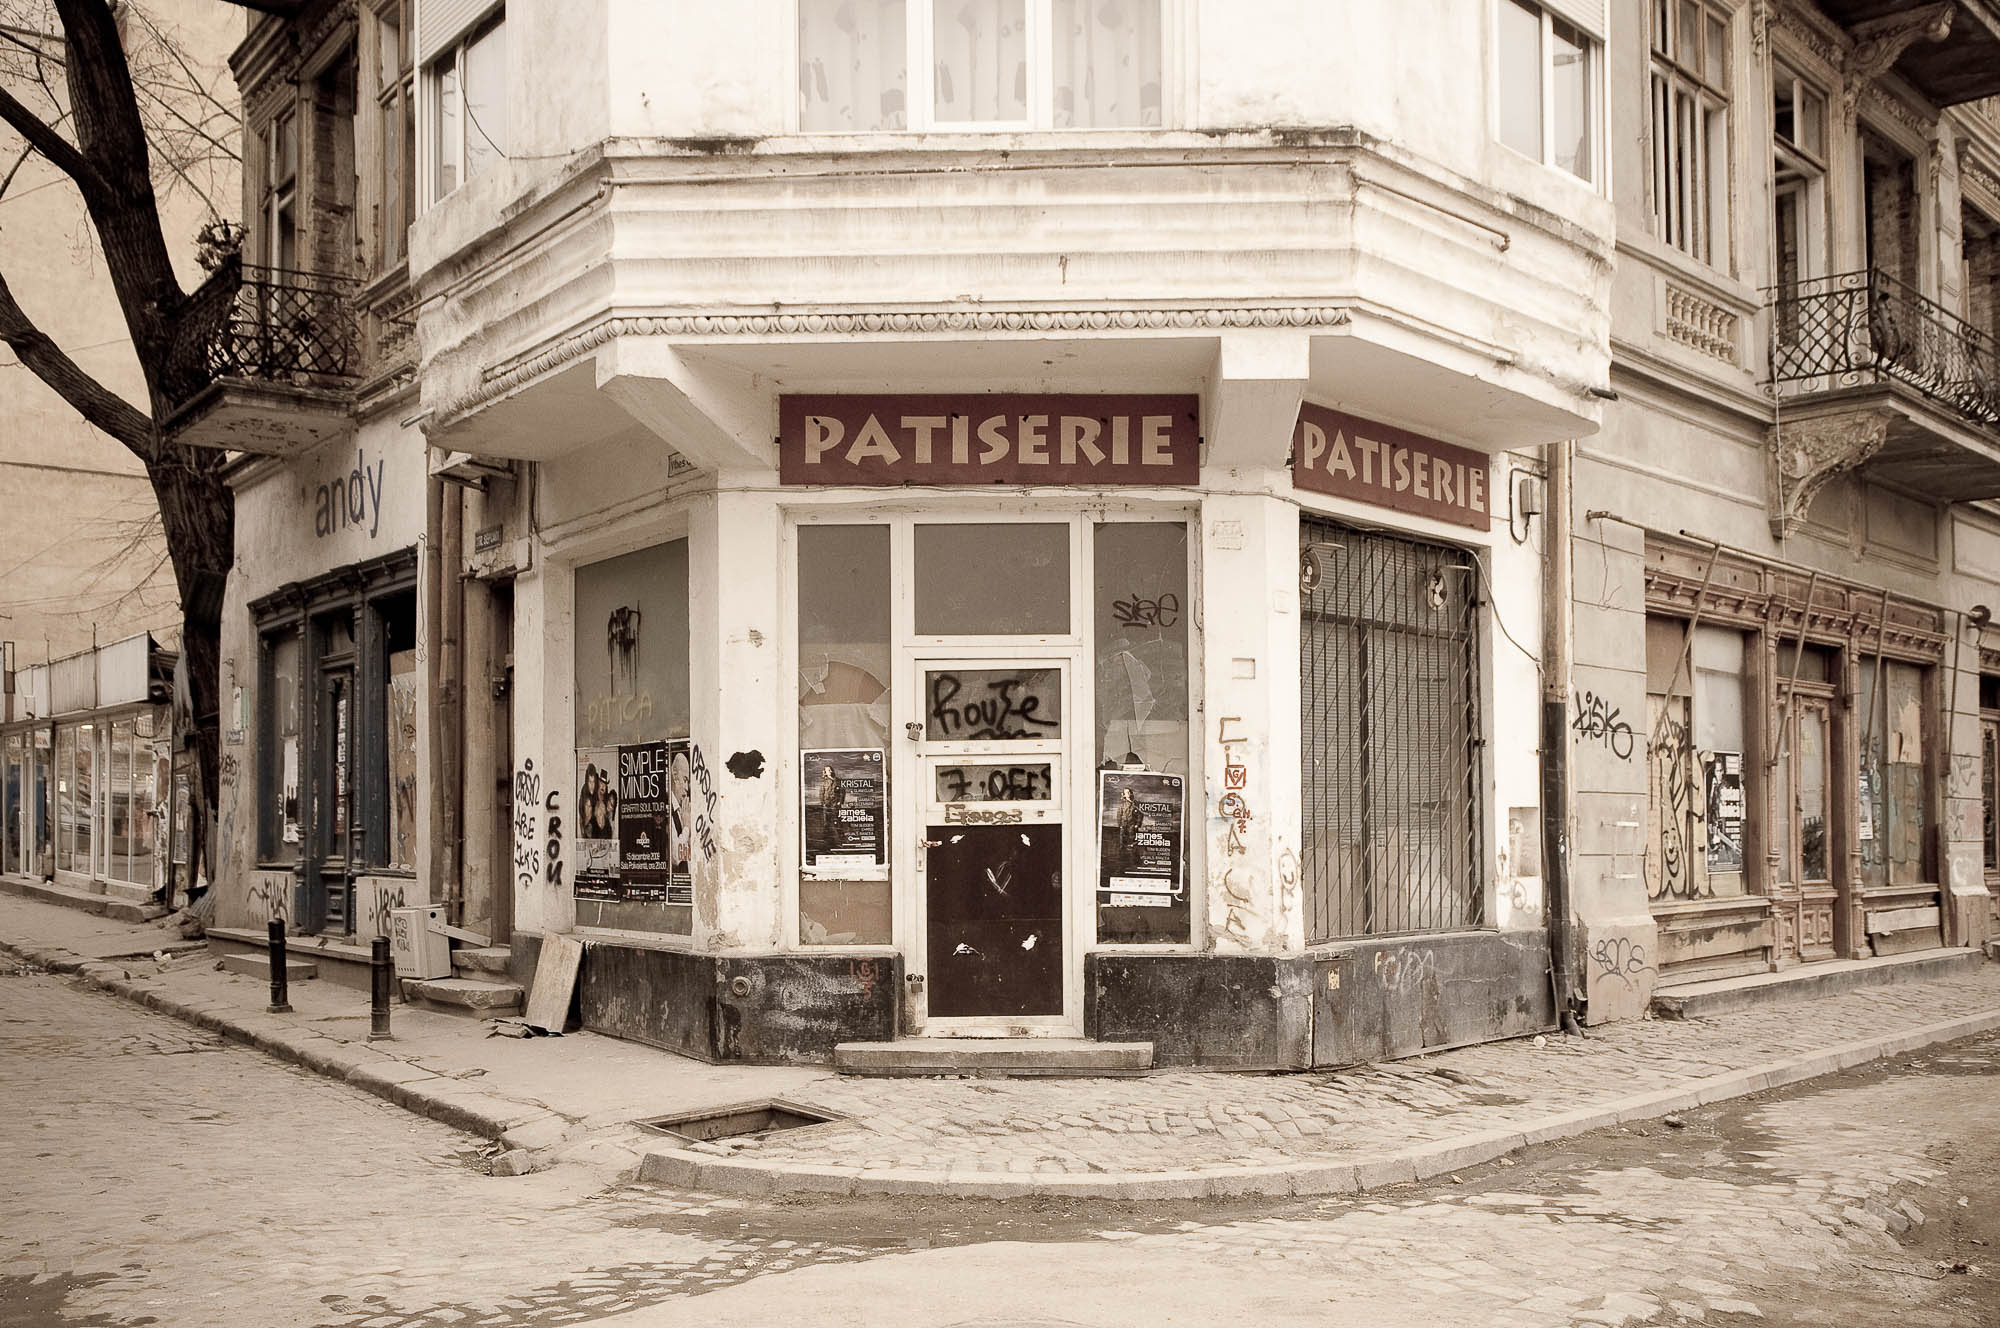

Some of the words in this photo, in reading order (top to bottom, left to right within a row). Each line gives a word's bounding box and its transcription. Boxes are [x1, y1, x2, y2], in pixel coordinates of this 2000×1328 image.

[804, 413, 1174, 467] PATISERIE
[1302, 420, 1486, 514] PATISERIE
[315, 448, 384, 539] andy
[620, 749, 665, 777] SIMPLE
[620, 773, 660, 800] MINDS
[840, 779, 874, 788] KRISTAL
[1138, 803, 1172, 812] KRISTAL
[837, 808, 866, 818] james
[840, 813, 874, 822] zabiela
[1134, 832, 1163, 841] james
[1137, 838, 1171, 847] zabiela
